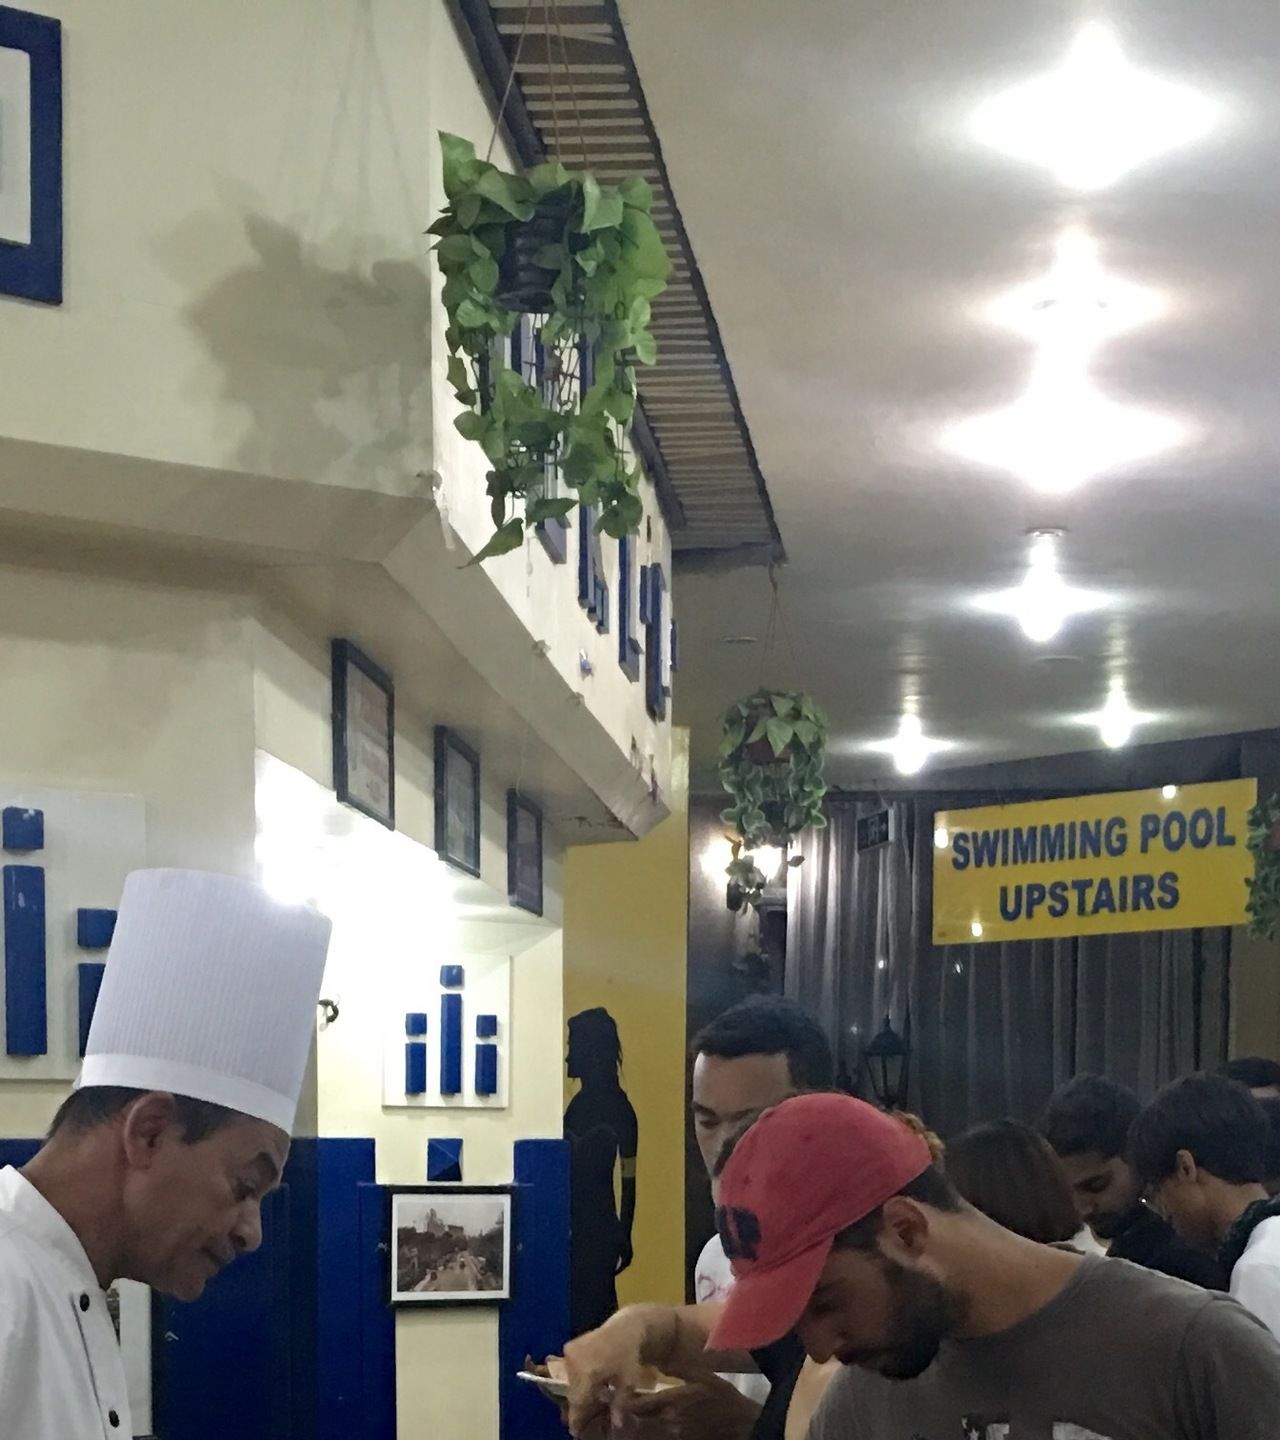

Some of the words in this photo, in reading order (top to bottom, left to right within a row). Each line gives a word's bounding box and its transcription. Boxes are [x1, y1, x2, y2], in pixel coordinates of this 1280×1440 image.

[951, 816, 1128, 870] SWIMMING
[1140, 807, 1236, 854] POOL
[999, 871, 1180, 921] UPSTAIRS
